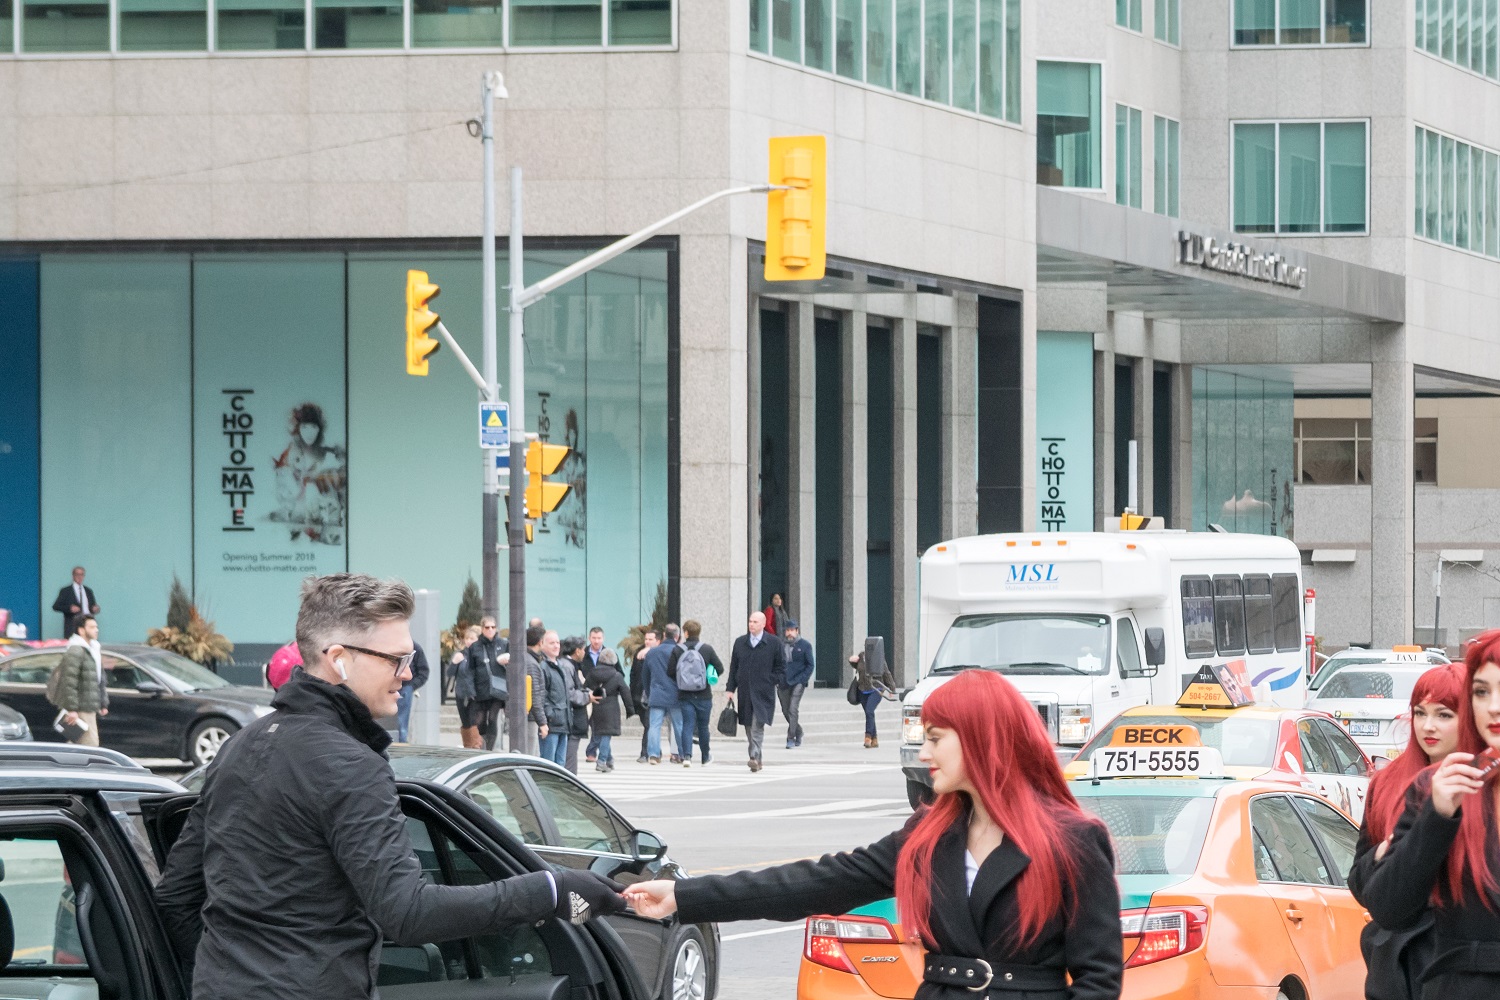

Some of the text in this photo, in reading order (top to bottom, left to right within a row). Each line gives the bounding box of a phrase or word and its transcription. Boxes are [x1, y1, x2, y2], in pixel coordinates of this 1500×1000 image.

[222, 552, 316, 562] Opening Summer 2018
[222, 564, 317, 573] www.chotto-matte.com
[1006, 563, 1060, 582] MSL
[1189, 692, 1221, 700] 504-2667
[1124, 729, 1184, 743] BECK
[1104, 751, 1200, 771] 751-5555
[861, 955, 899, 963] CAMRY
